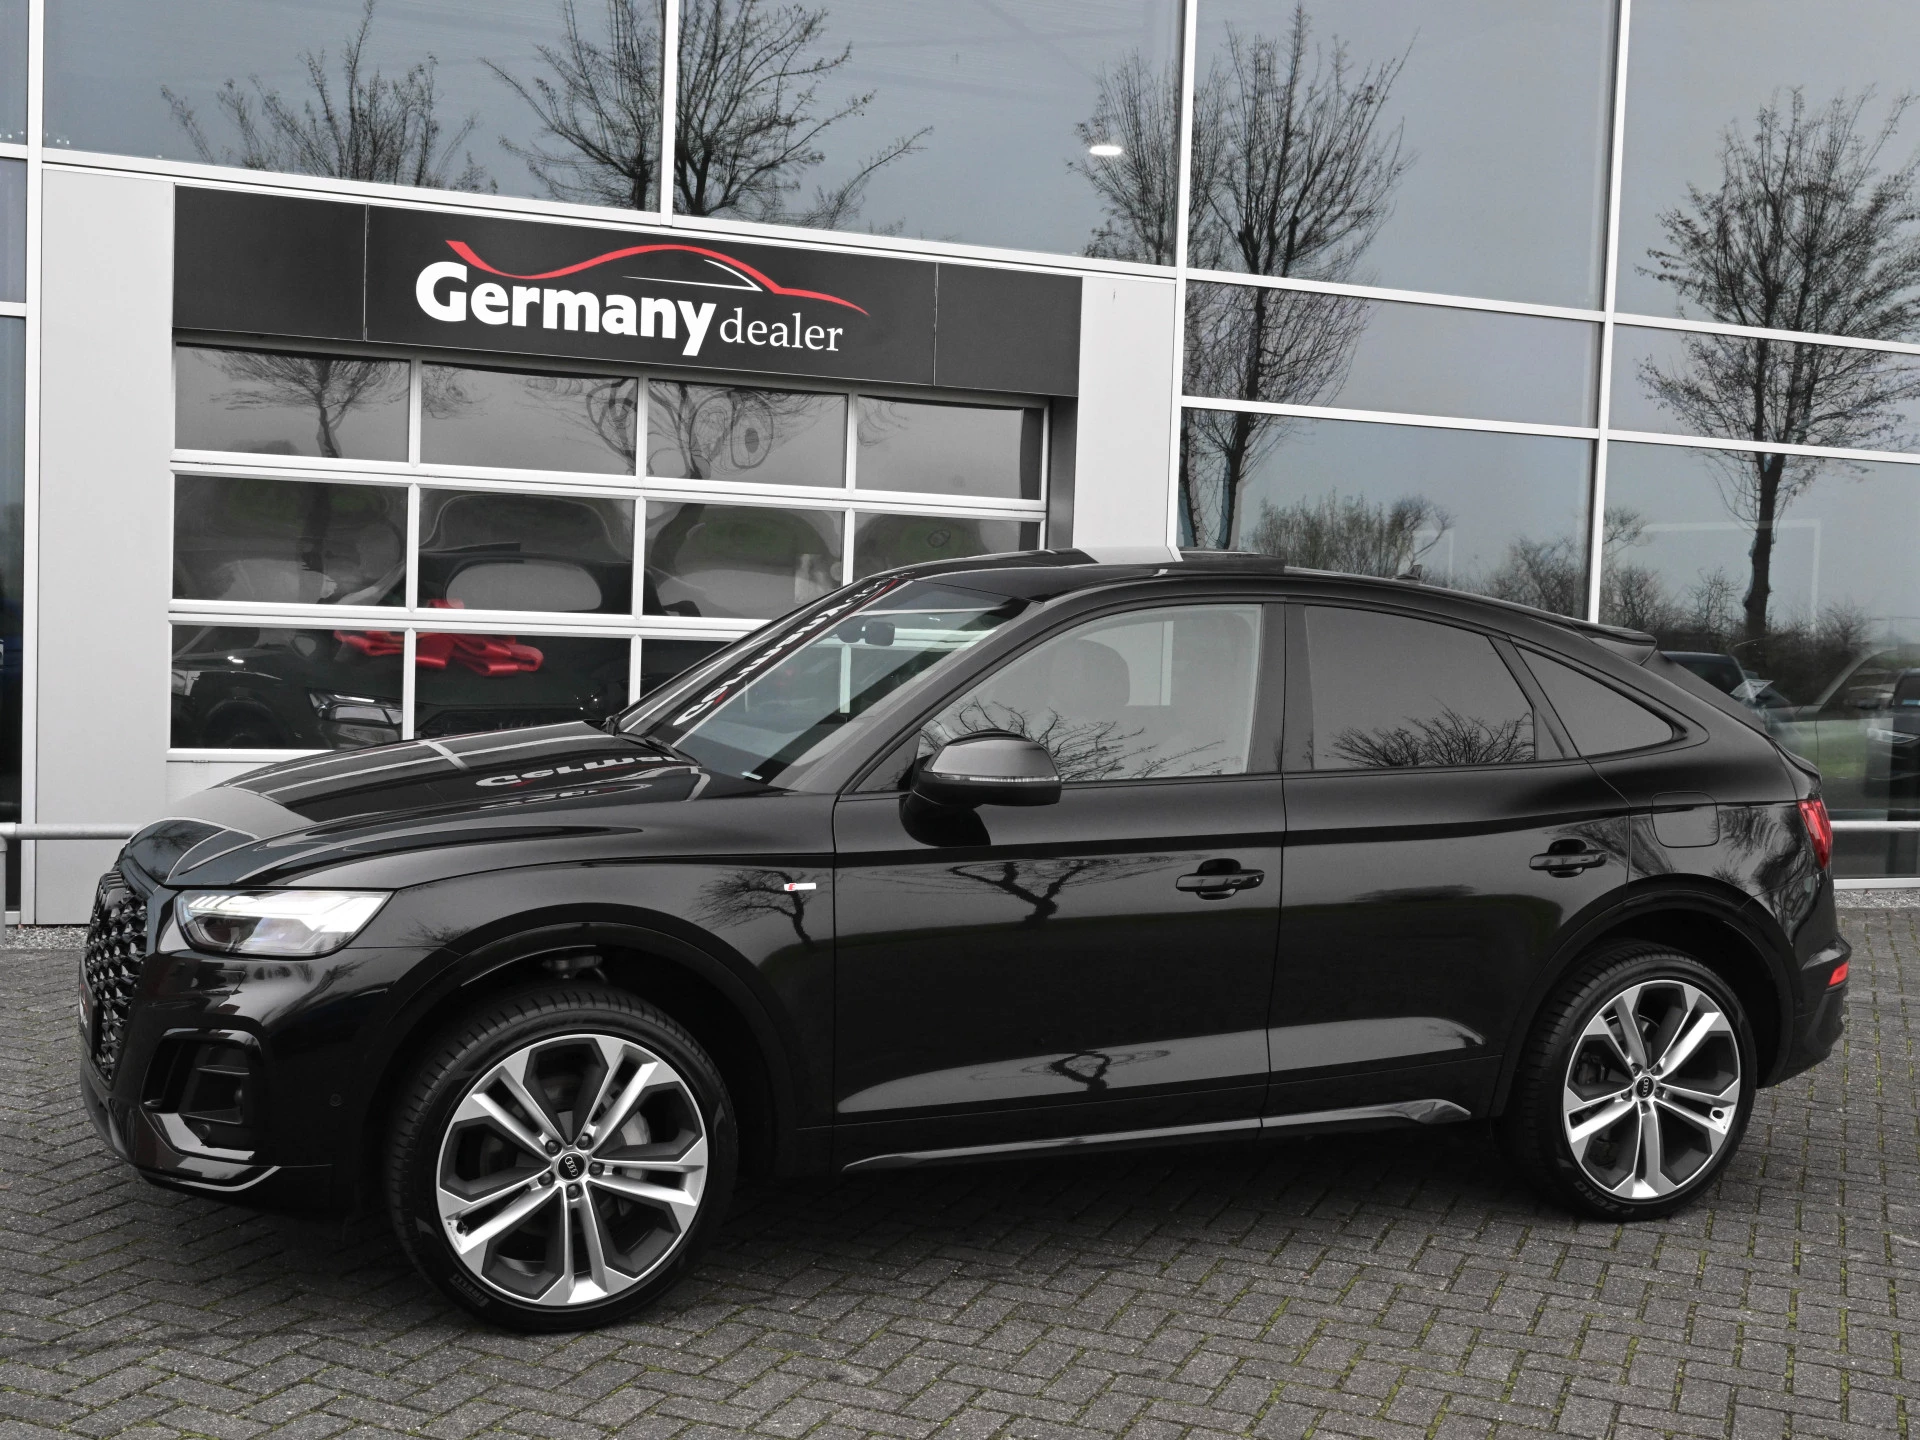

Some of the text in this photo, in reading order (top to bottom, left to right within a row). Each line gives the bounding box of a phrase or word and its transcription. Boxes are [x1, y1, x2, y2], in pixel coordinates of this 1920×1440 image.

[415, 261, 843, 356] Germany dealer
[1573, 1180, 1620, 1212] ZERO
